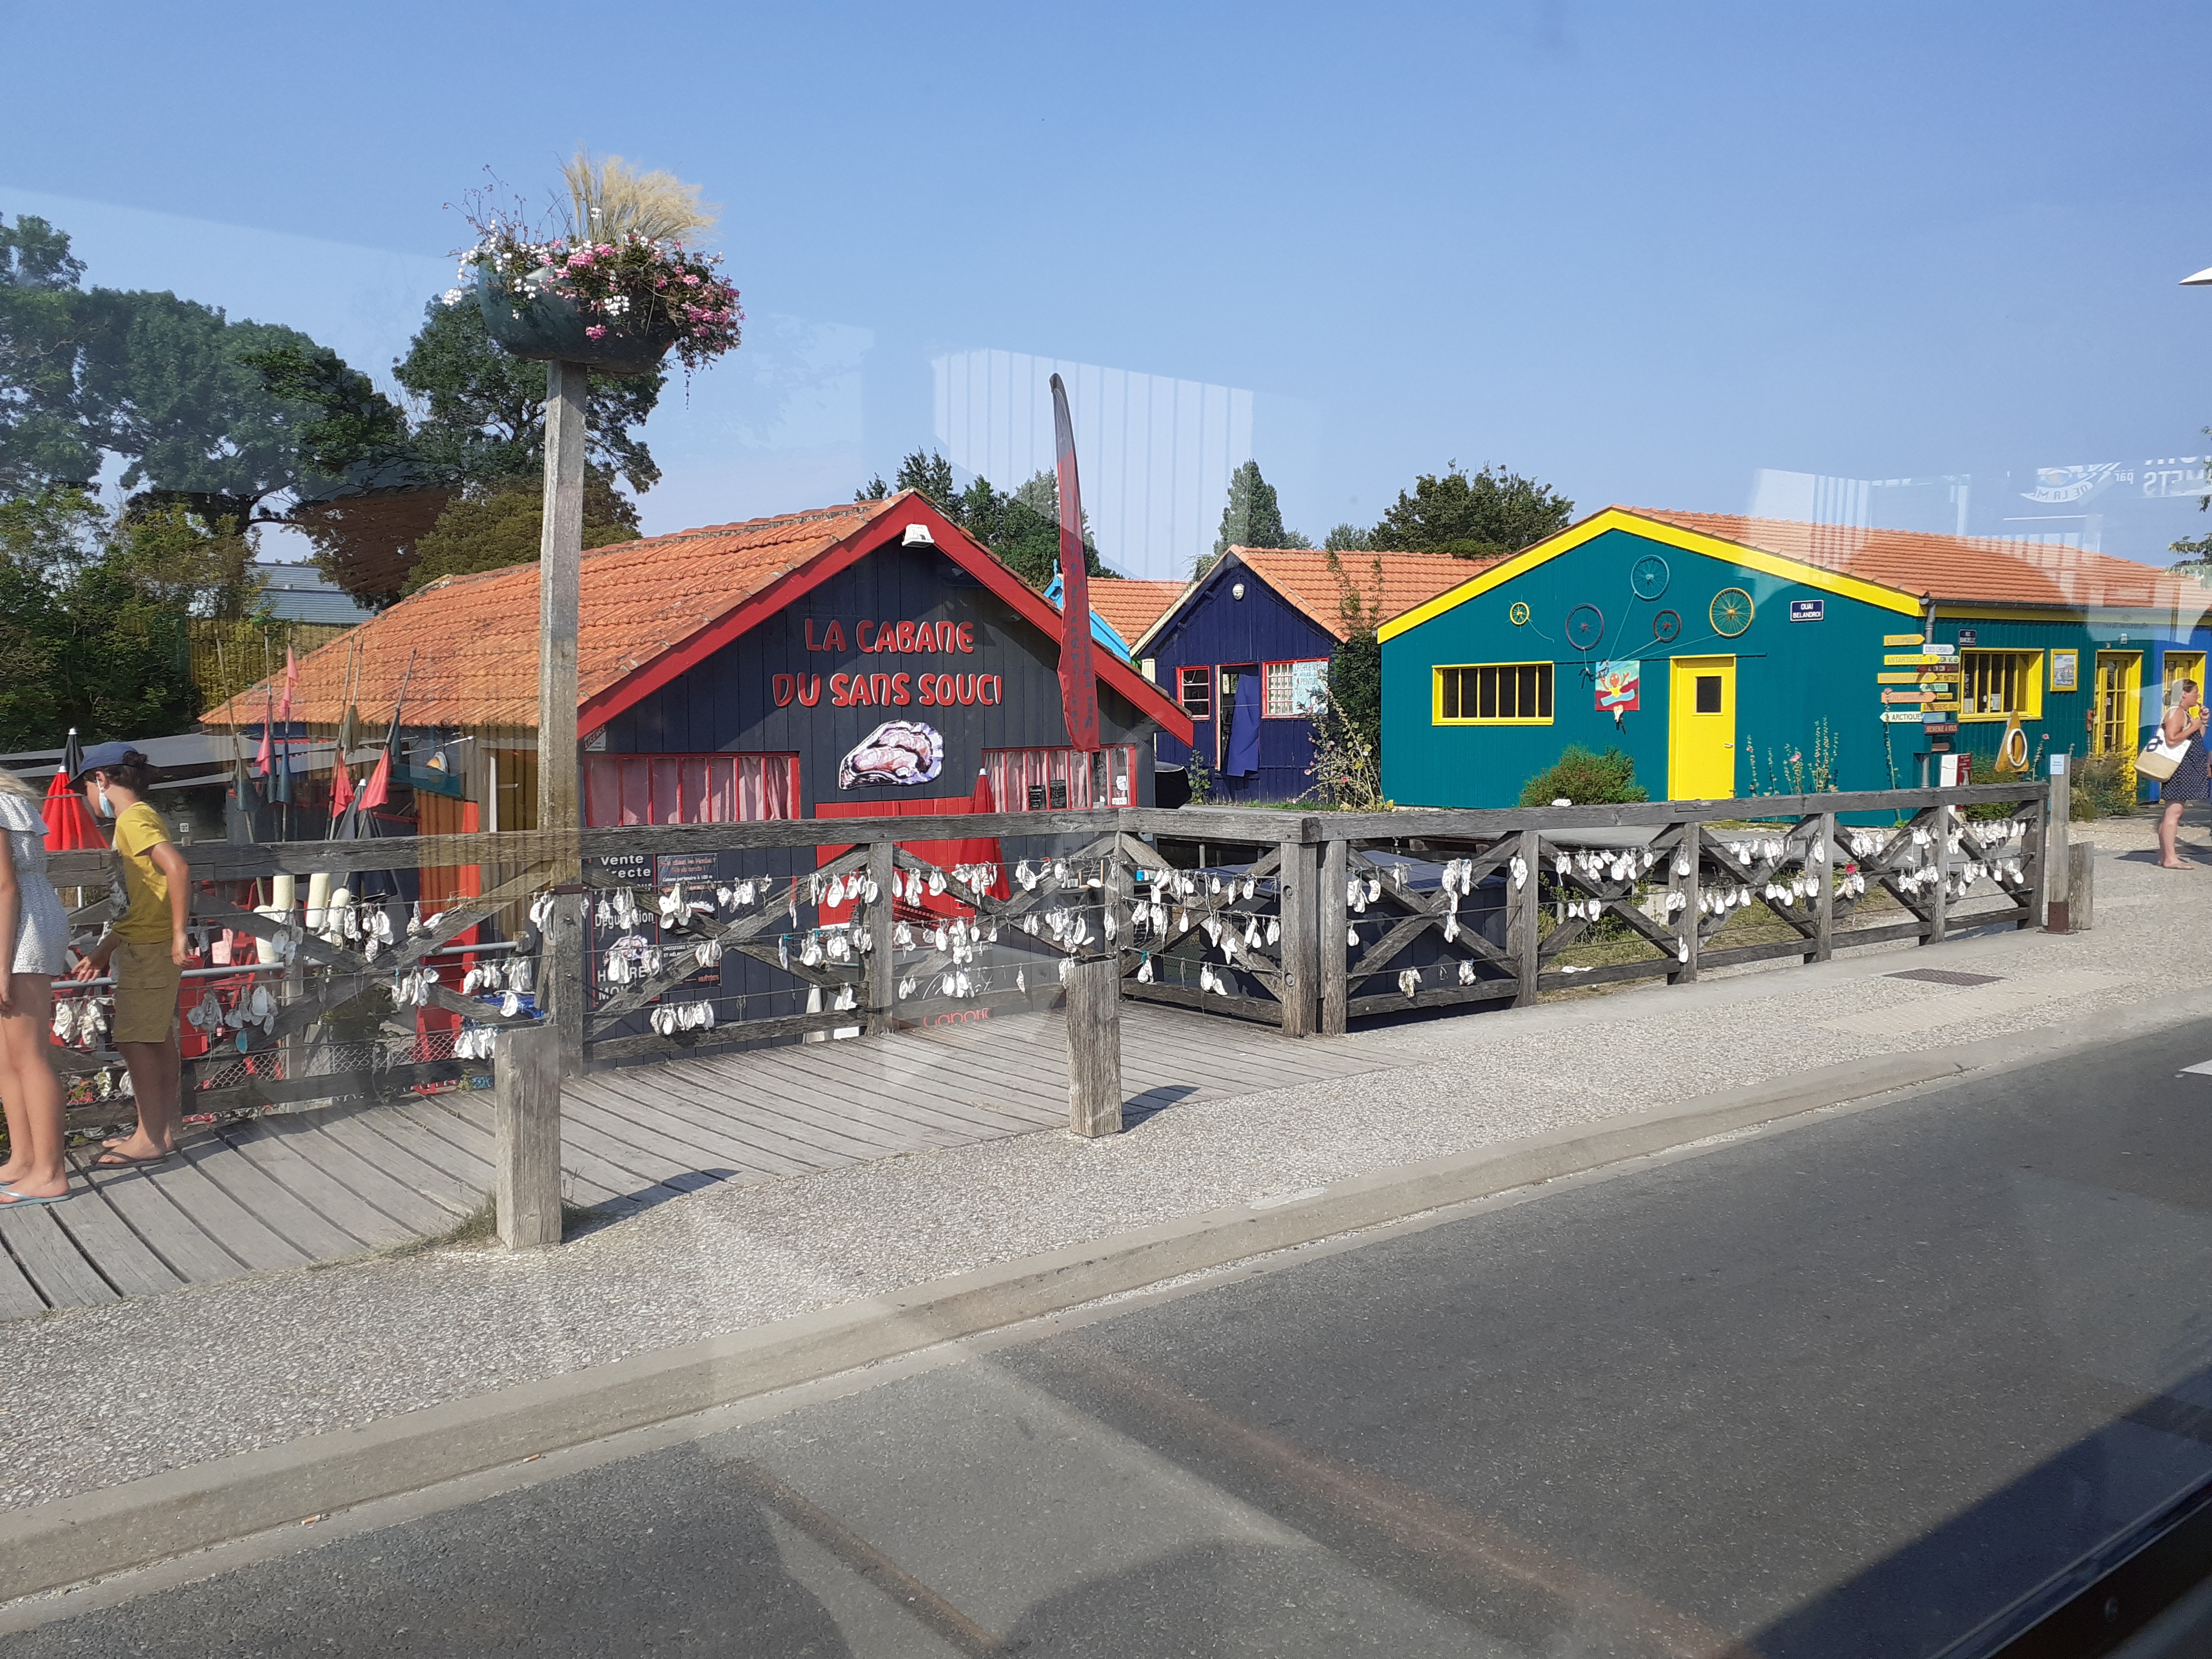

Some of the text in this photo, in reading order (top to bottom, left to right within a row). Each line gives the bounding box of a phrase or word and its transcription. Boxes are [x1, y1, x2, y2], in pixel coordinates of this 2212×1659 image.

[805, 618, 974, 653] LA CABANE
[772, 672, 1002, 707] DU SANS SOUCI
[585, 724, 606, 749] LICENCE
[600, 855, 644, 865] Vente
